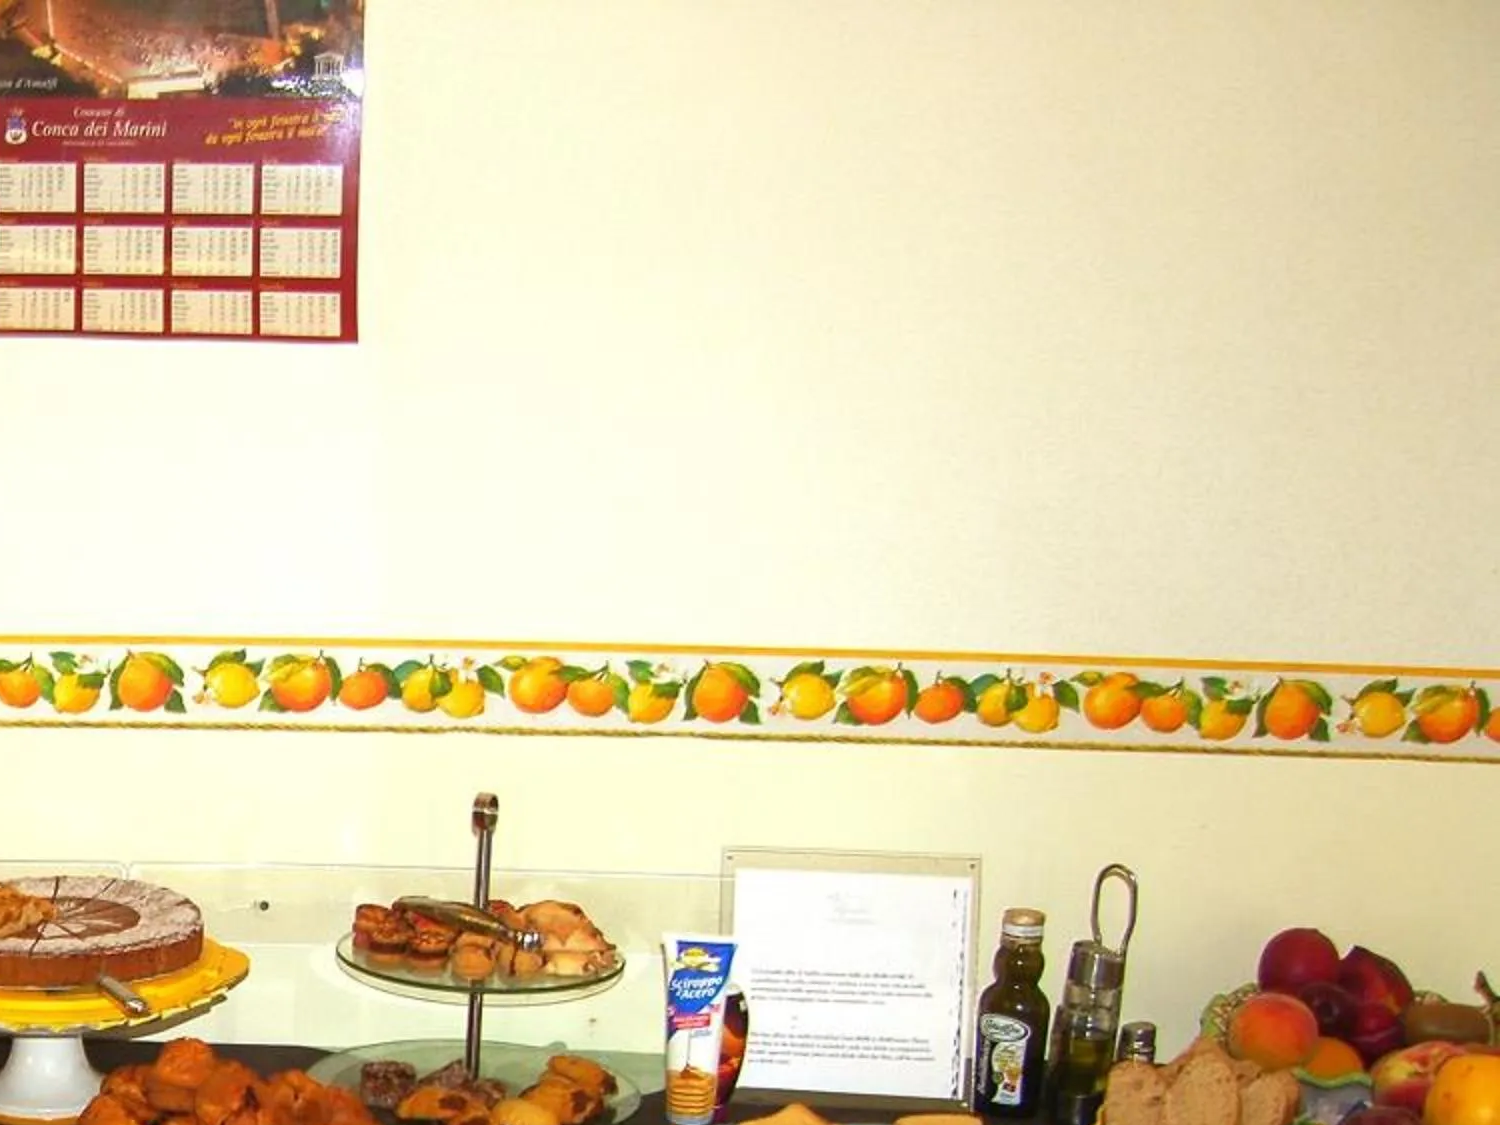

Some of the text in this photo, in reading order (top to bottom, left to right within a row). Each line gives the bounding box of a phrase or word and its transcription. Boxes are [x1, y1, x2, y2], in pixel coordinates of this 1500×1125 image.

[31, 119, 168, 138] Conca dei Marini
